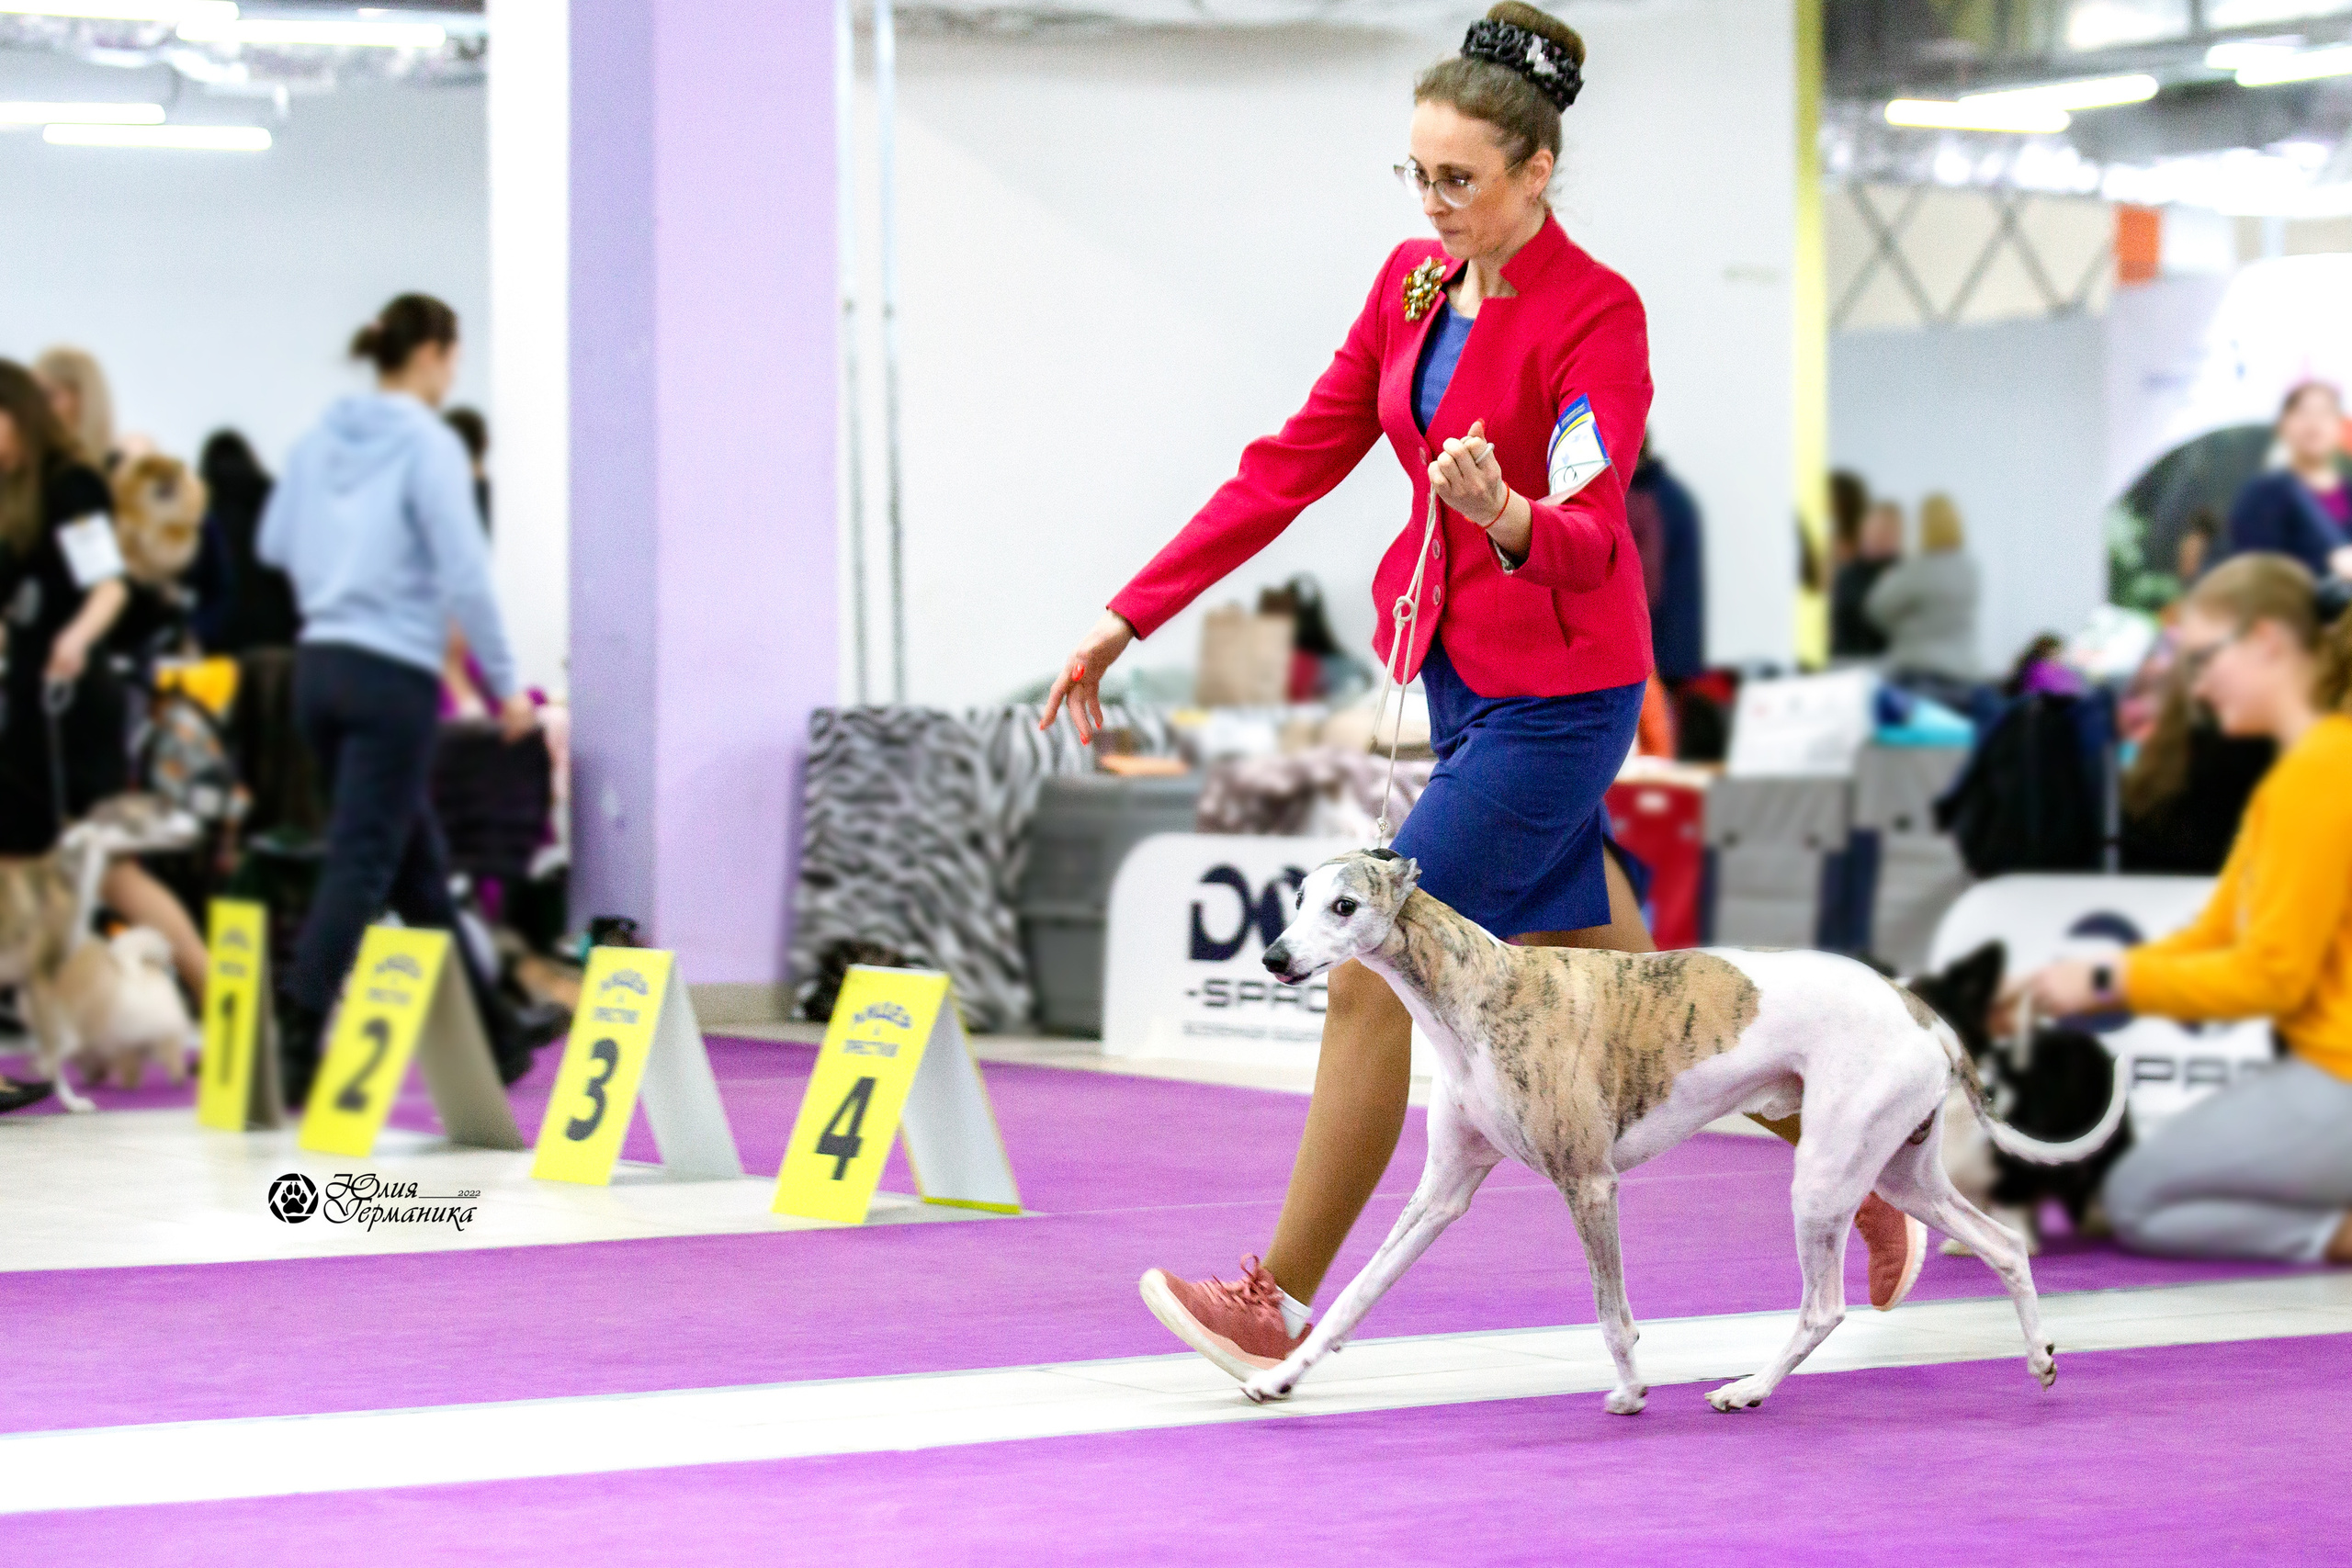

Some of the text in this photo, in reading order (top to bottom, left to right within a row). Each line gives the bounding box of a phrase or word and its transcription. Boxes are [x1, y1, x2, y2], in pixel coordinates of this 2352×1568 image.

[220, 992, 238, 1087] 1
[335, 1016, 392, 1112] 2
[566, 1037, 619, 1141] 3
[815, 1076, 878, 1181] 4
